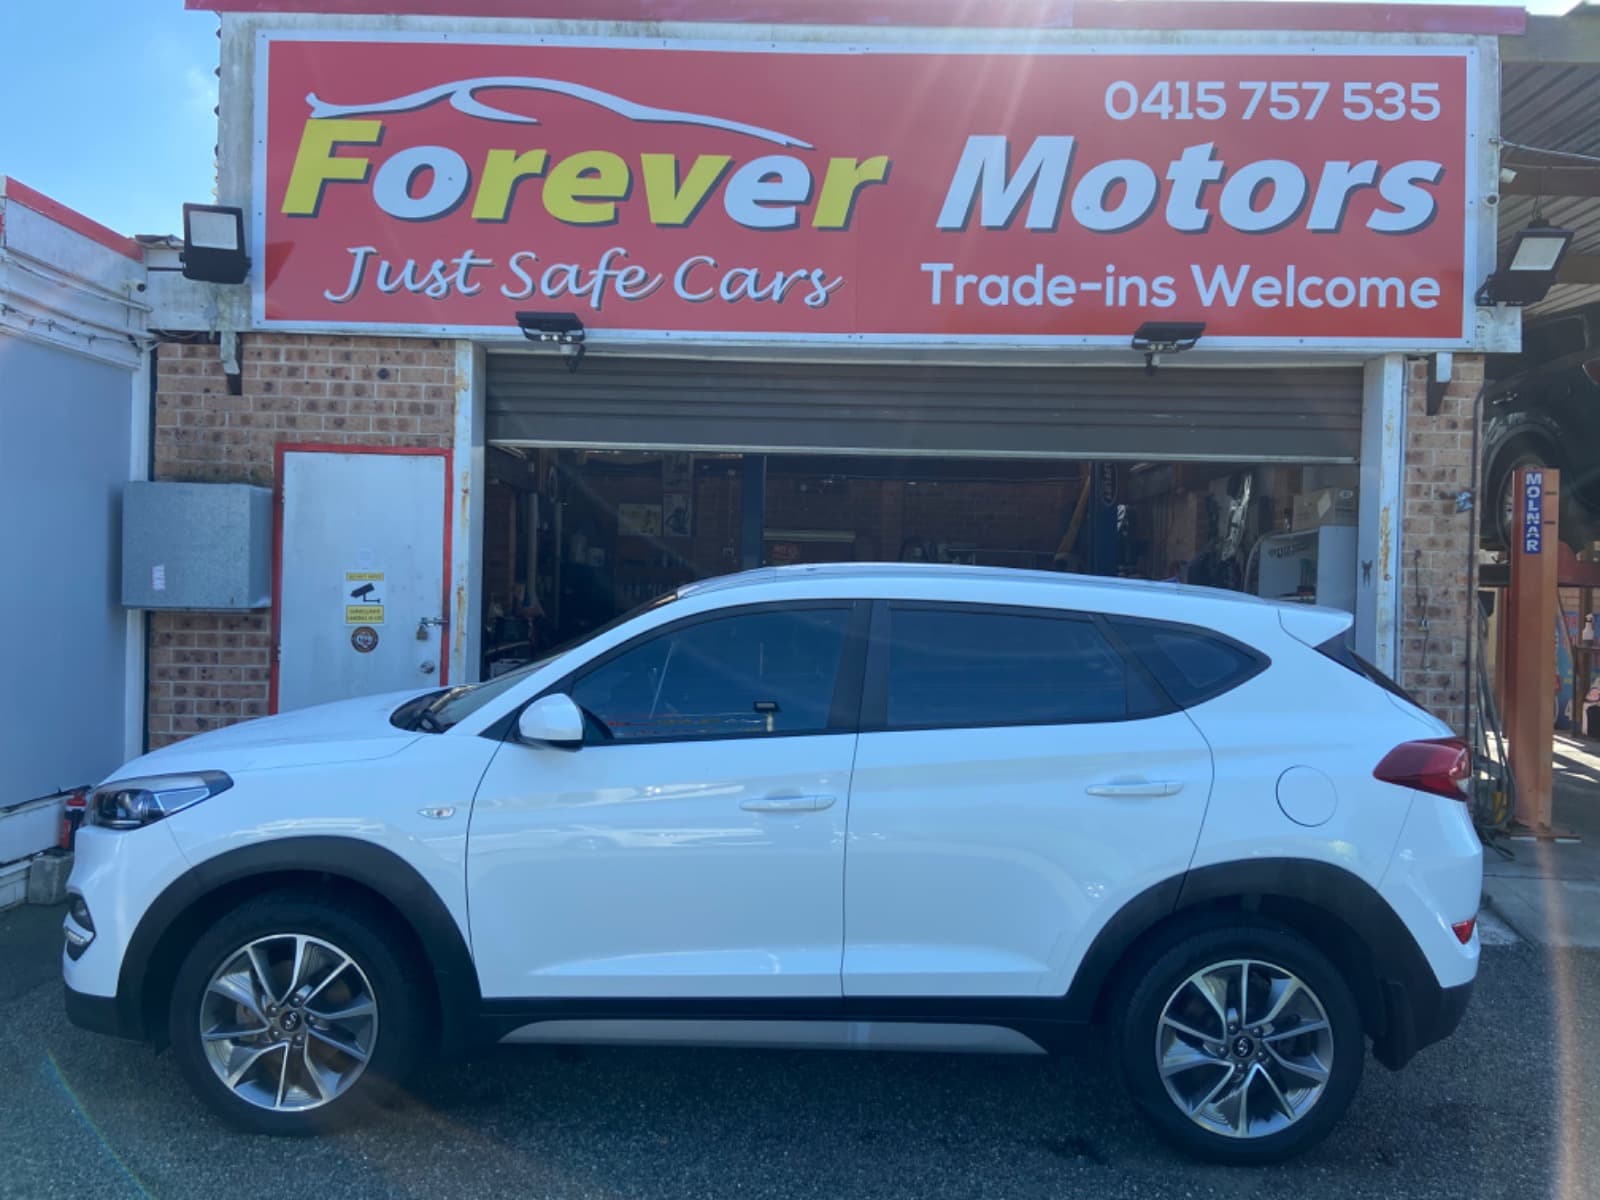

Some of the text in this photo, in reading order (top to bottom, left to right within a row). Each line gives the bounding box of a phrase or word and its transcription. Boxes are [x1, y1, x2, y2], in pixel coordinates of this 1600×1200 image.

[1104, 80, 1441, 122] 0415 757 535
[281, 118, 1445, 236] Forever Motors
[323, 246, 844, 310] Just Safe Cars
[920, 262, 1441, 309] Trade-ins Welcome
[1525, 472, 1542, 552] MOLNAR
